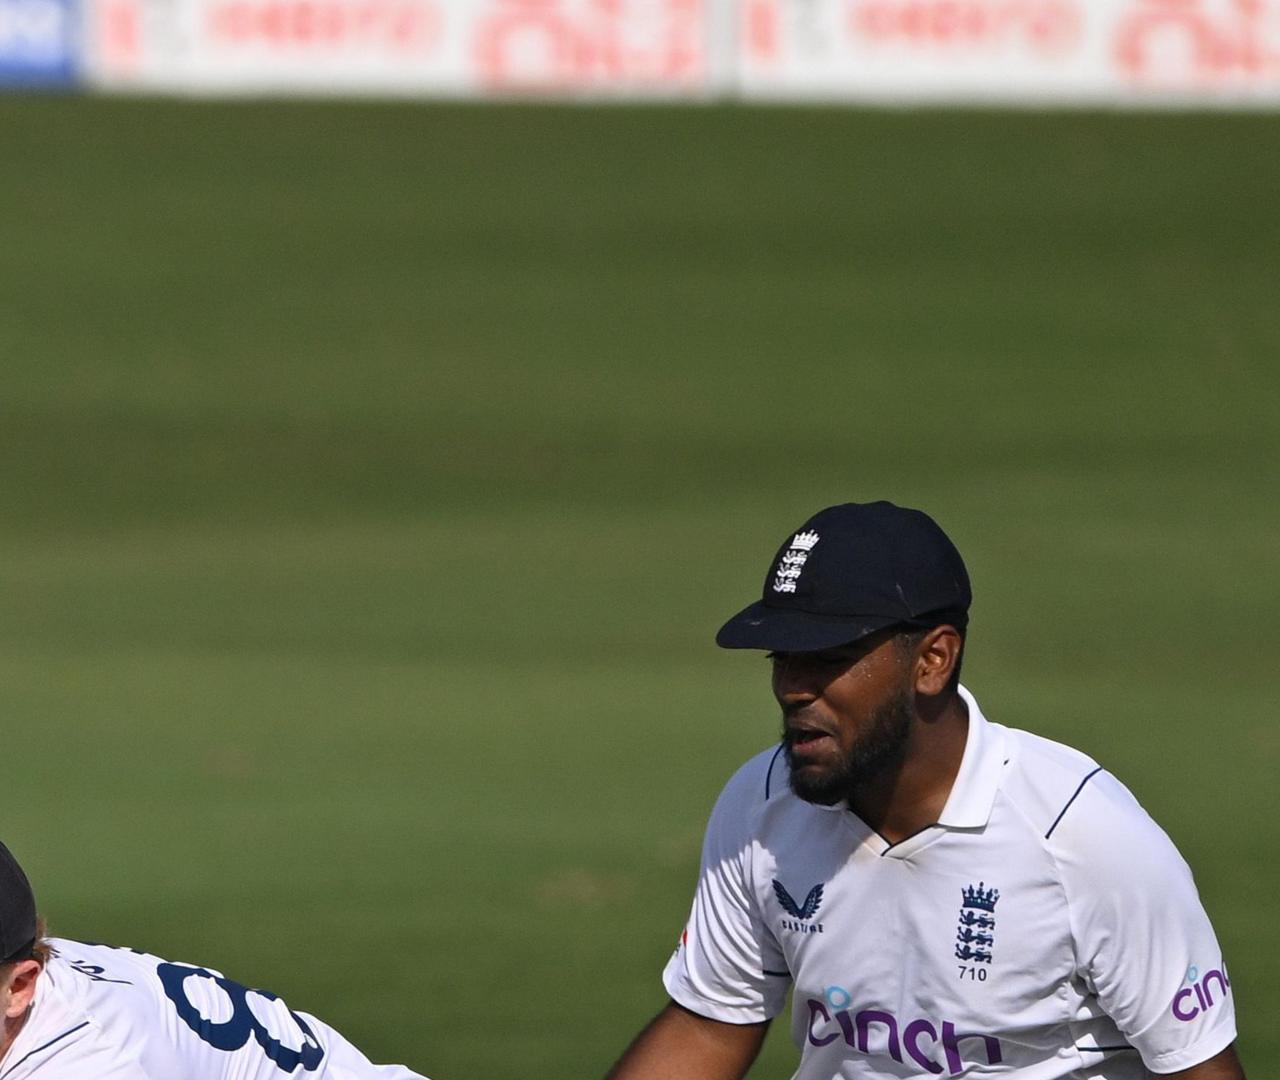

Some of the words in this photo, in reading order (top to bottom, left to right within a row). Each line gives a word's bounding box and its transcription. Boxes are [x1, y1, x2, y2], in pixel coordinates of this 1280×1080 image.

[958, 965, 987, 981] 710
[1172, 961, 1230, 1022] cin
[807, 985, 1002, 1075] cinch
